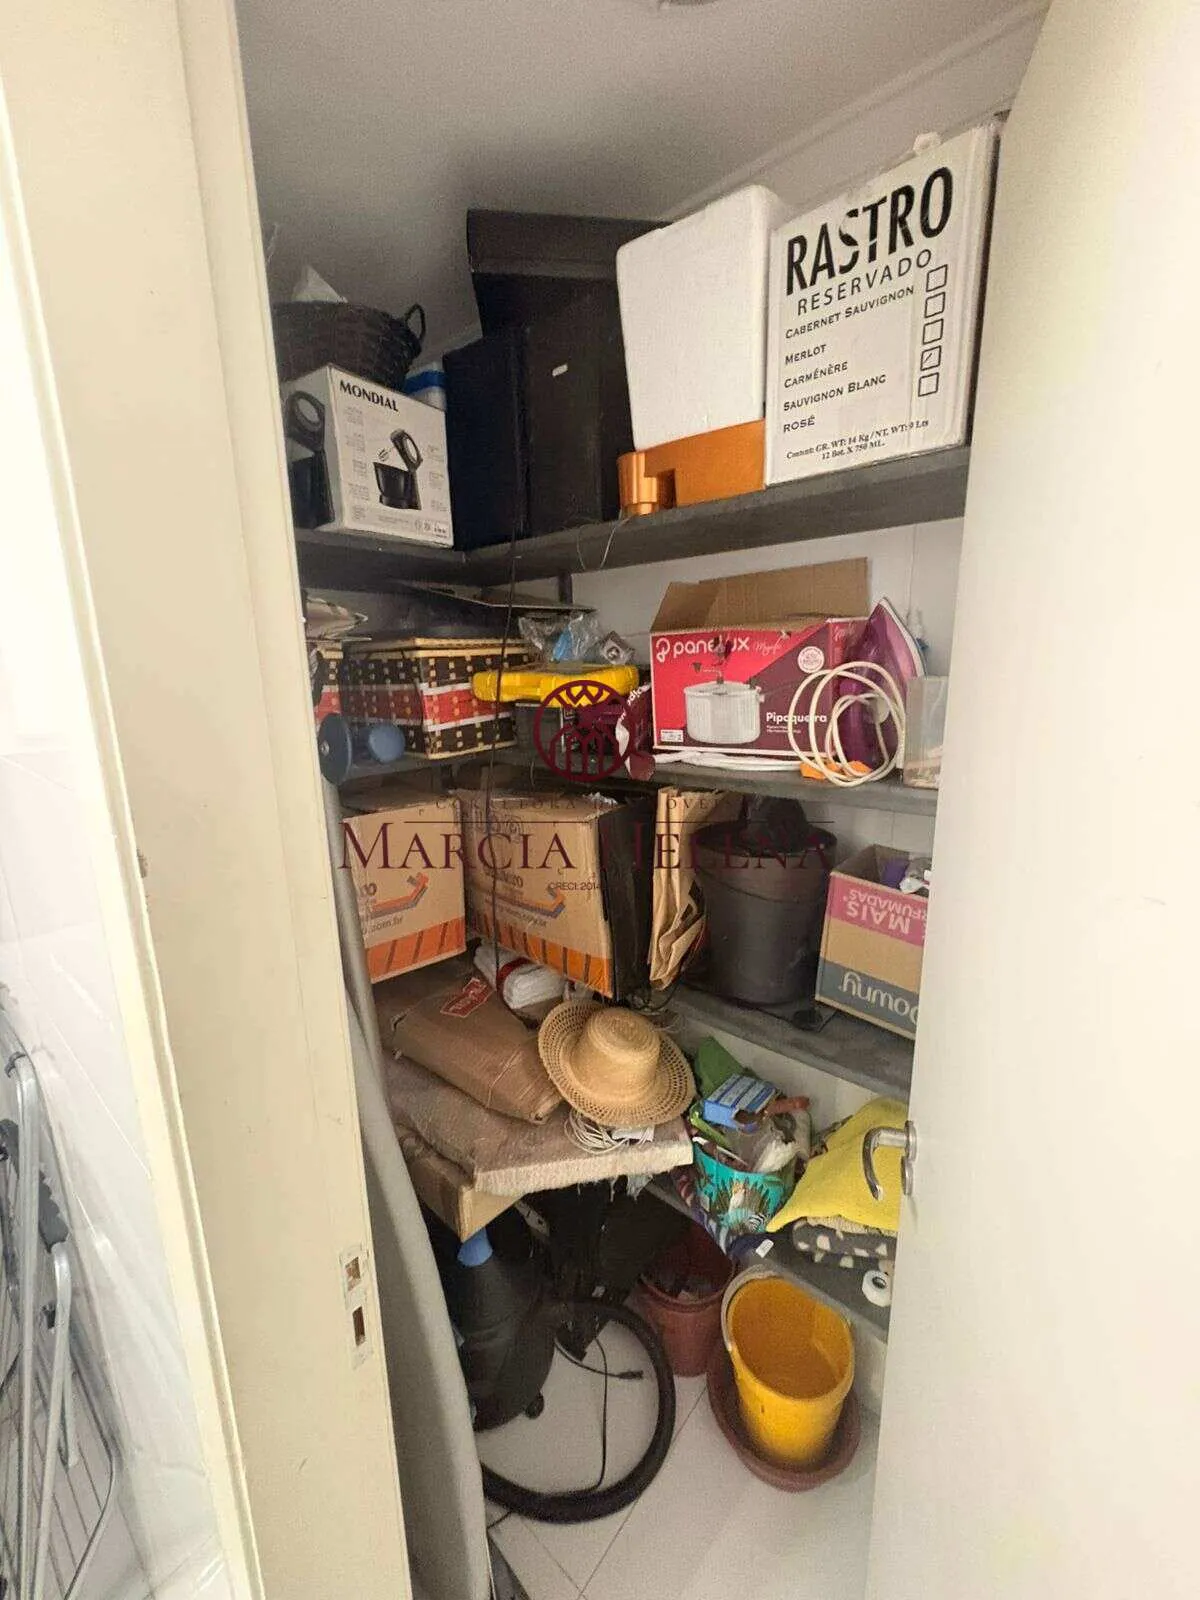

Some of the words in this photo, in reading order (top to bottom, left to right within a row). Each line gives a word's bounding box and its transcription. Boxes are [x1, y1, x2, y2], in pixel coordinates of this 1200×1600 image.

[786, 166, 954, 296] RASTRO
[798, 249, 932, 316] RESERVADO
[785, 313, 841, 339] CABERNET
[845, 285, 914, 319] SAUVIGNON
[785, 344, 827, 365] MERLOT
[784, 361, 848, 388] CARMÉNÈRE
[339, 380, 399, 412] MONDIAL
[783, 386, 844, 411] SAUVIGNON
[848, 374, 887, 393] BLANC
[783, 415, 815, 433] ROSÉ
[673, 635, 749, 656] paneux
[847, 900, 911, 934] MAIS
